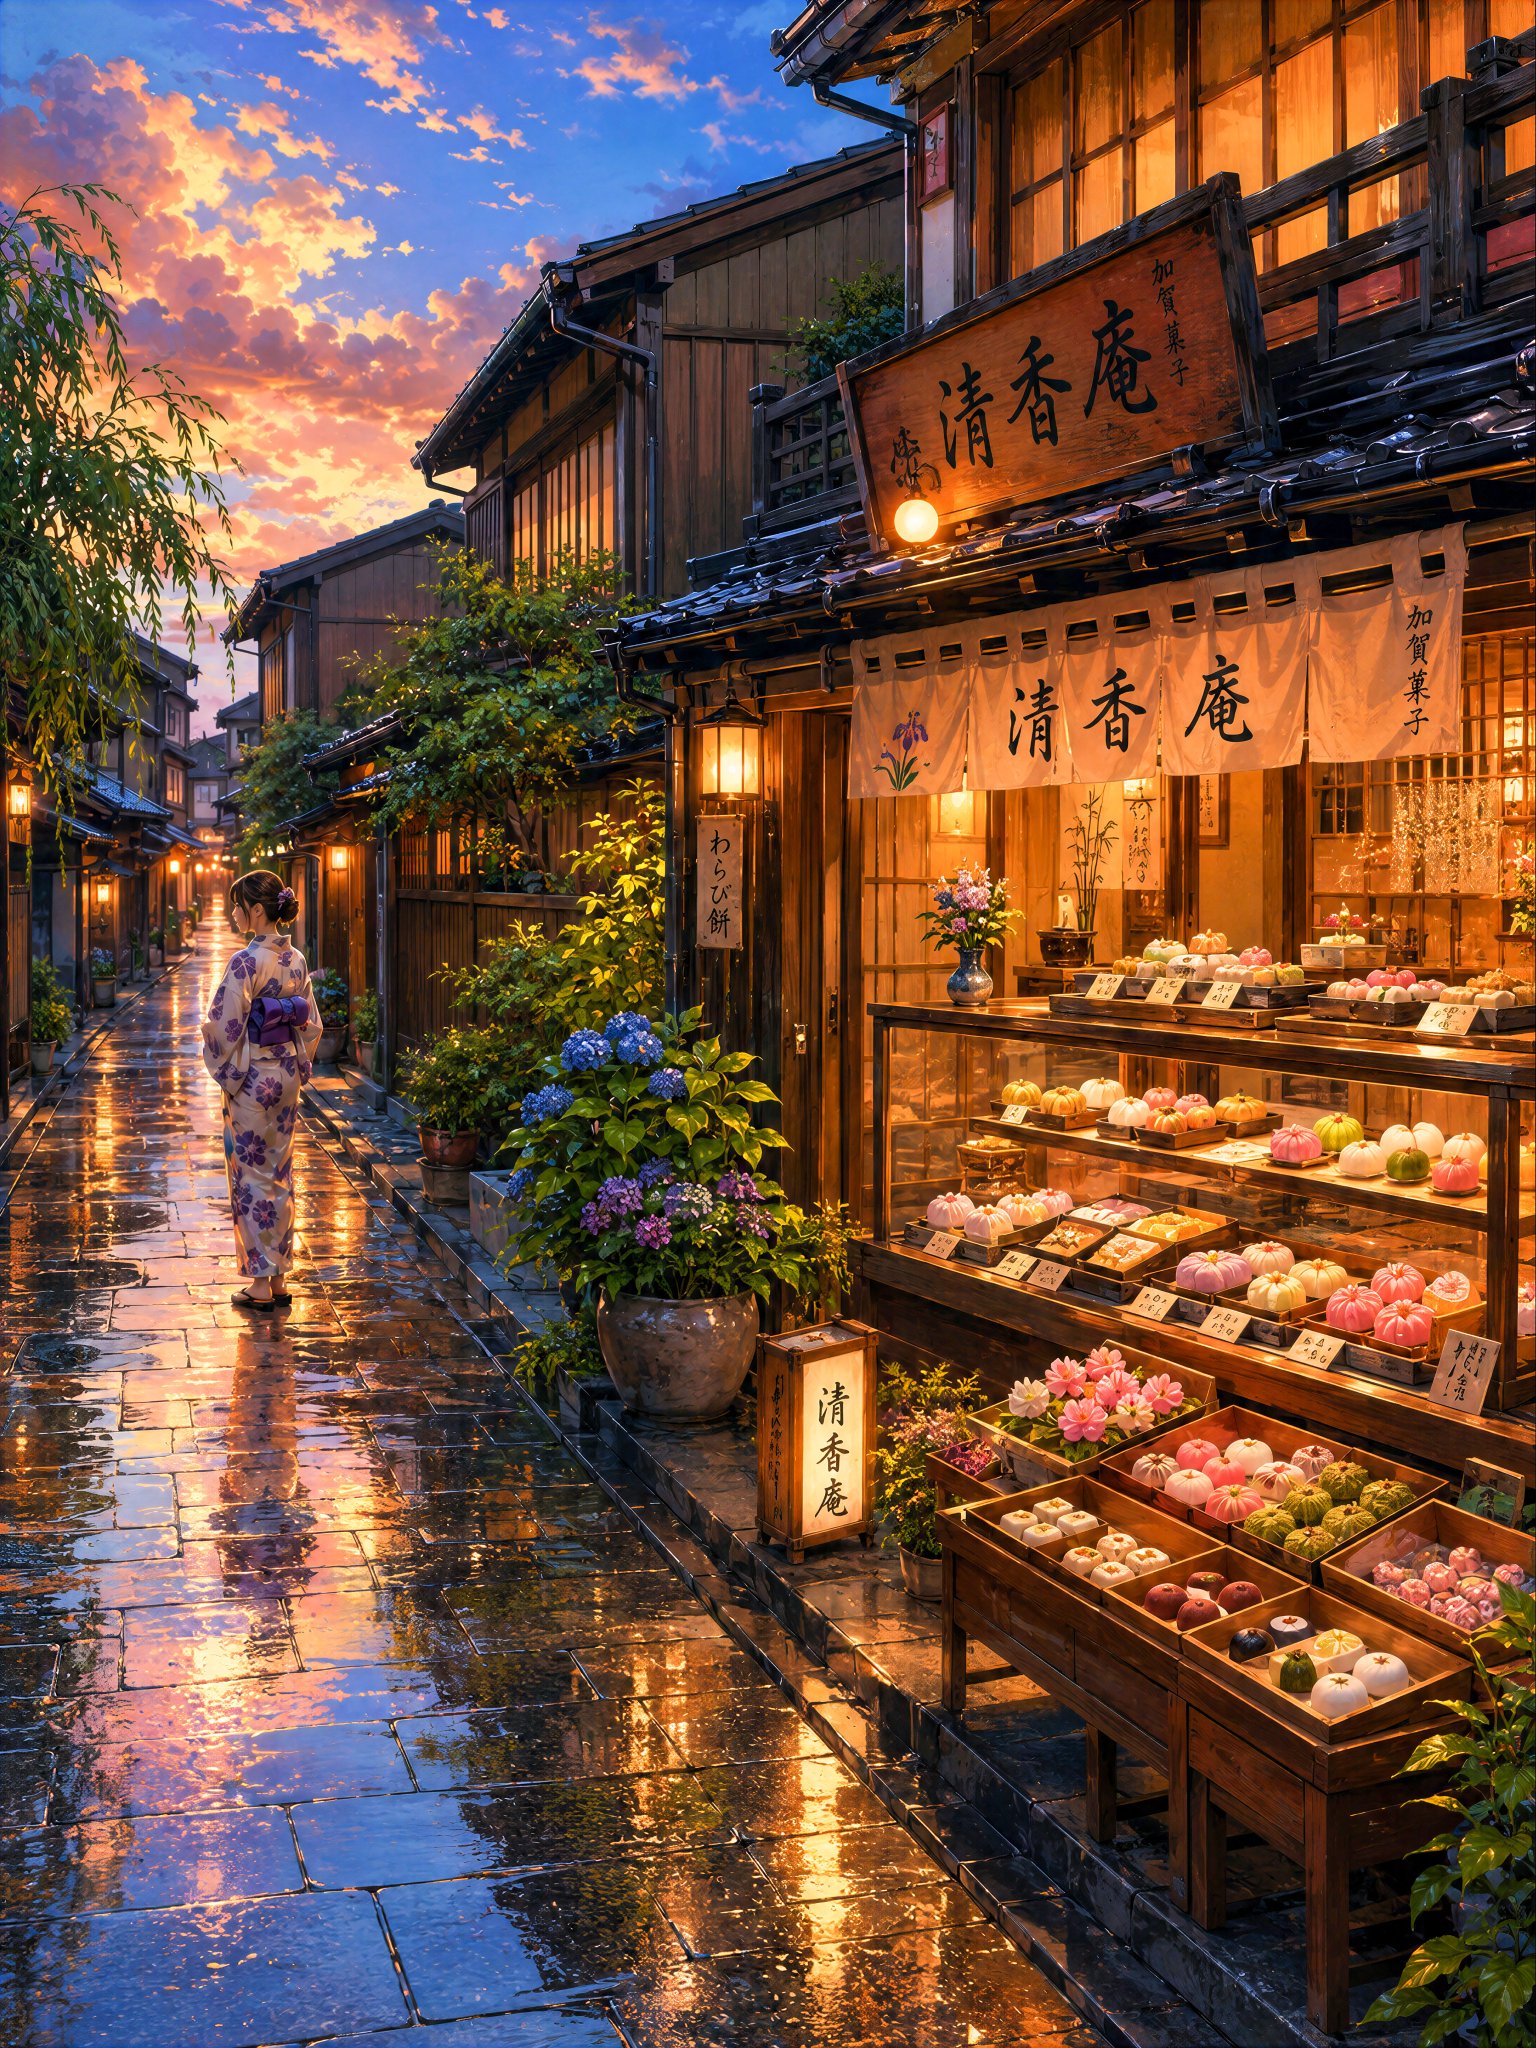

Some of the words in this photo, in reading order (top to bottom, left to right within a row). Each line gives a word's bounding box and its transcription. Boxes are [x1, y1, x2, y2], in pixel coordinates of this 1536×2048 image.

[939, 300, 1158, 469] 清香庵
[1151, 258, 1189, 387] 加賀菓子
[1008, 654, 1254, 763] 清香庵
[1403, 604, 1433, 736] 加賀菓子
[707, 830, 731, 938] わらび餅
[816, 1382, 850, 1518] 清香庵
